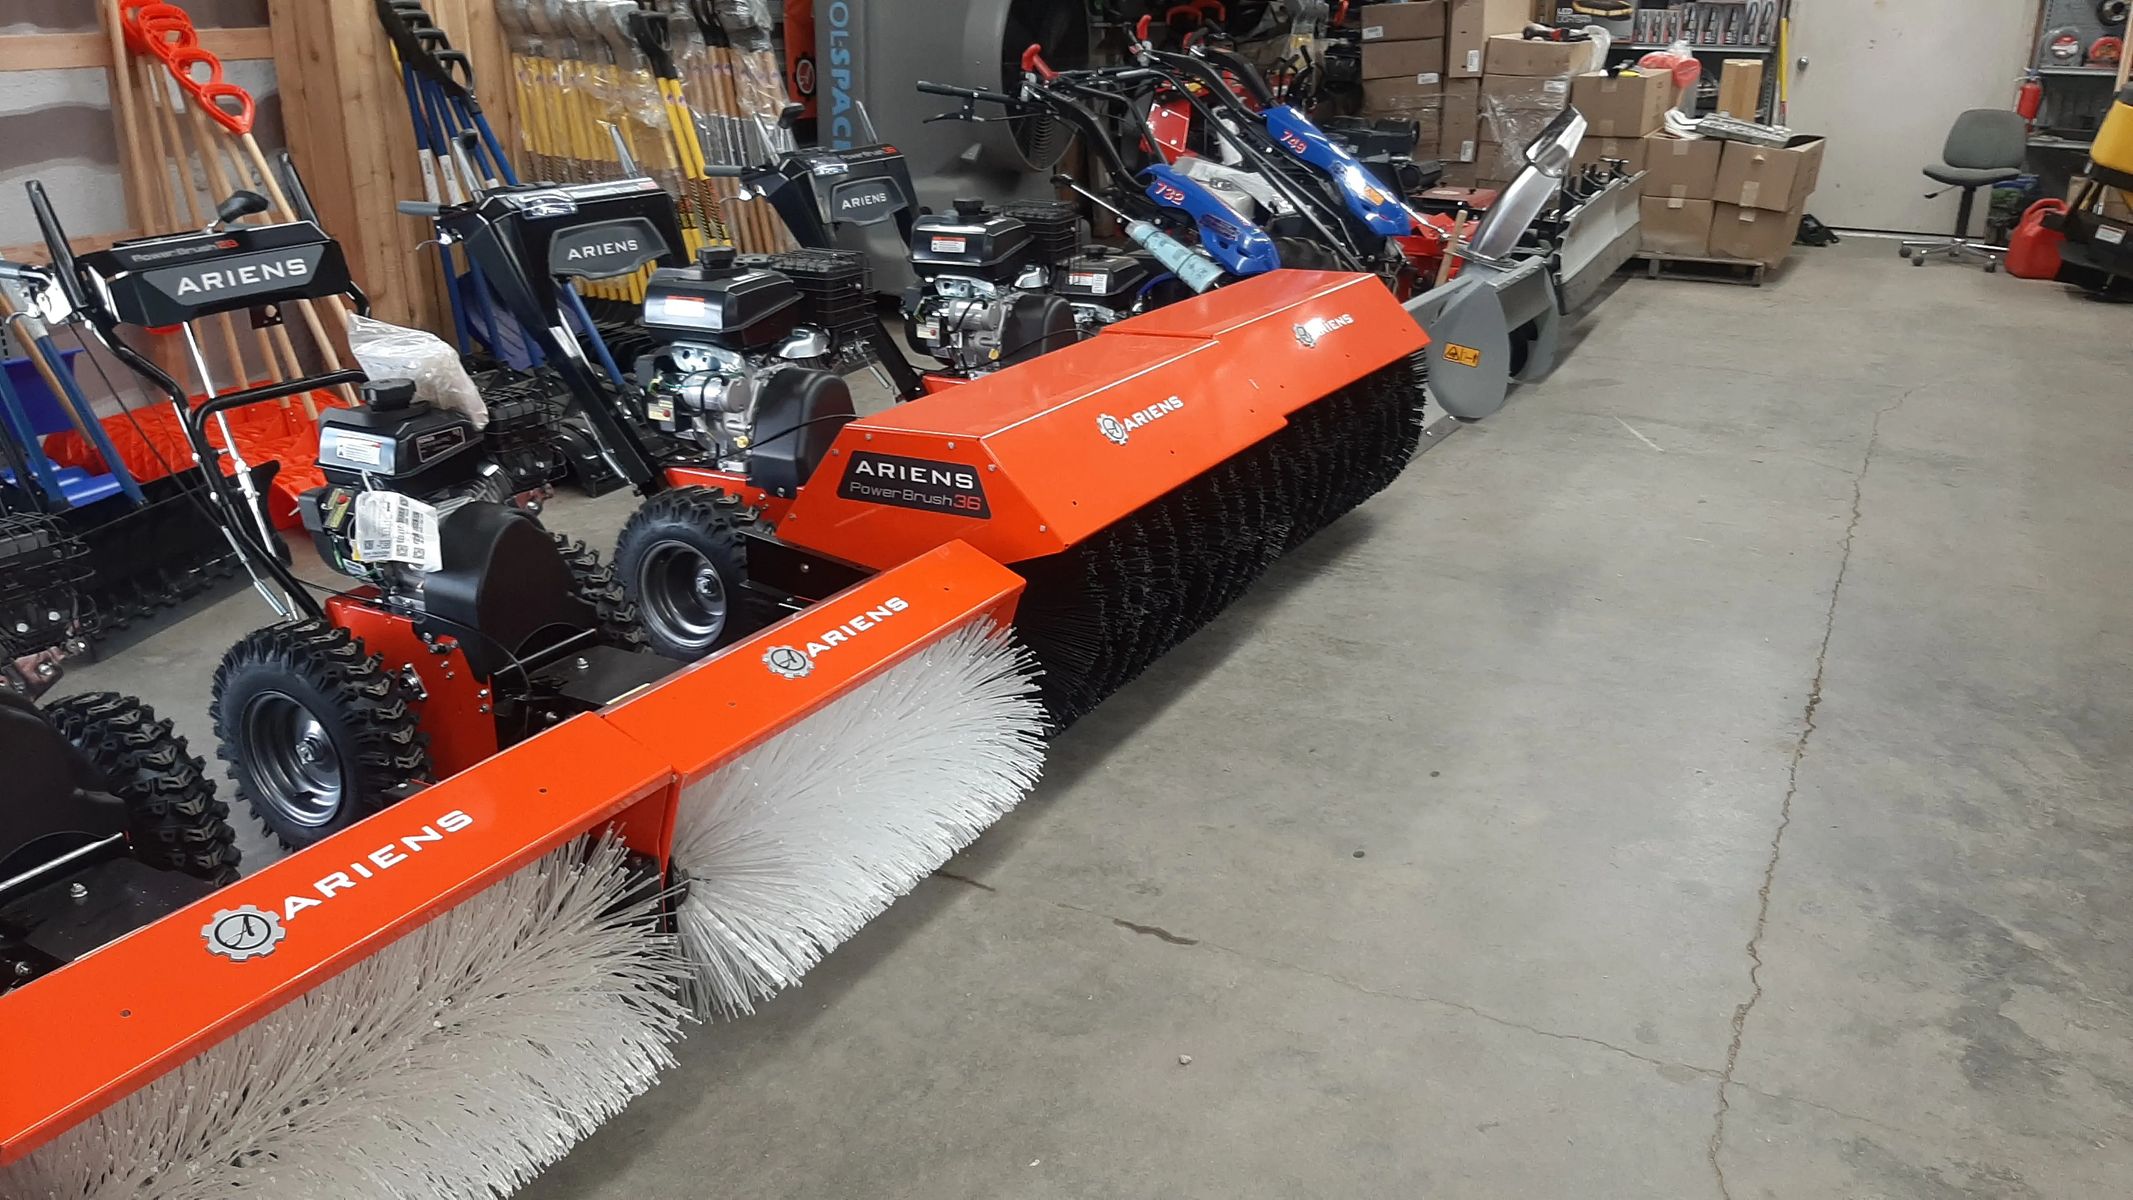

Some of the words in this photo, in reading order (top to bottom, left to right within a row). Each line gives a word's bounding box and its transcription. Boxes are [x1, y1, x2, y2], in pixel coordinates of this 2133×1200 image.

[841, 192, 887, 210] ARIENS
[567, 239, 639, 261] ARIENS
[177, 258, 308, 296] ARIENS
[1123, 395, 1184, 432] ARIENS
[855, 460, 974, 490] ARIENS
[849, 481, 982, 511] PowerBrush36
[805, 596, 909, 658] ARIENS
[284, 809, 474, 921] ARIENS
